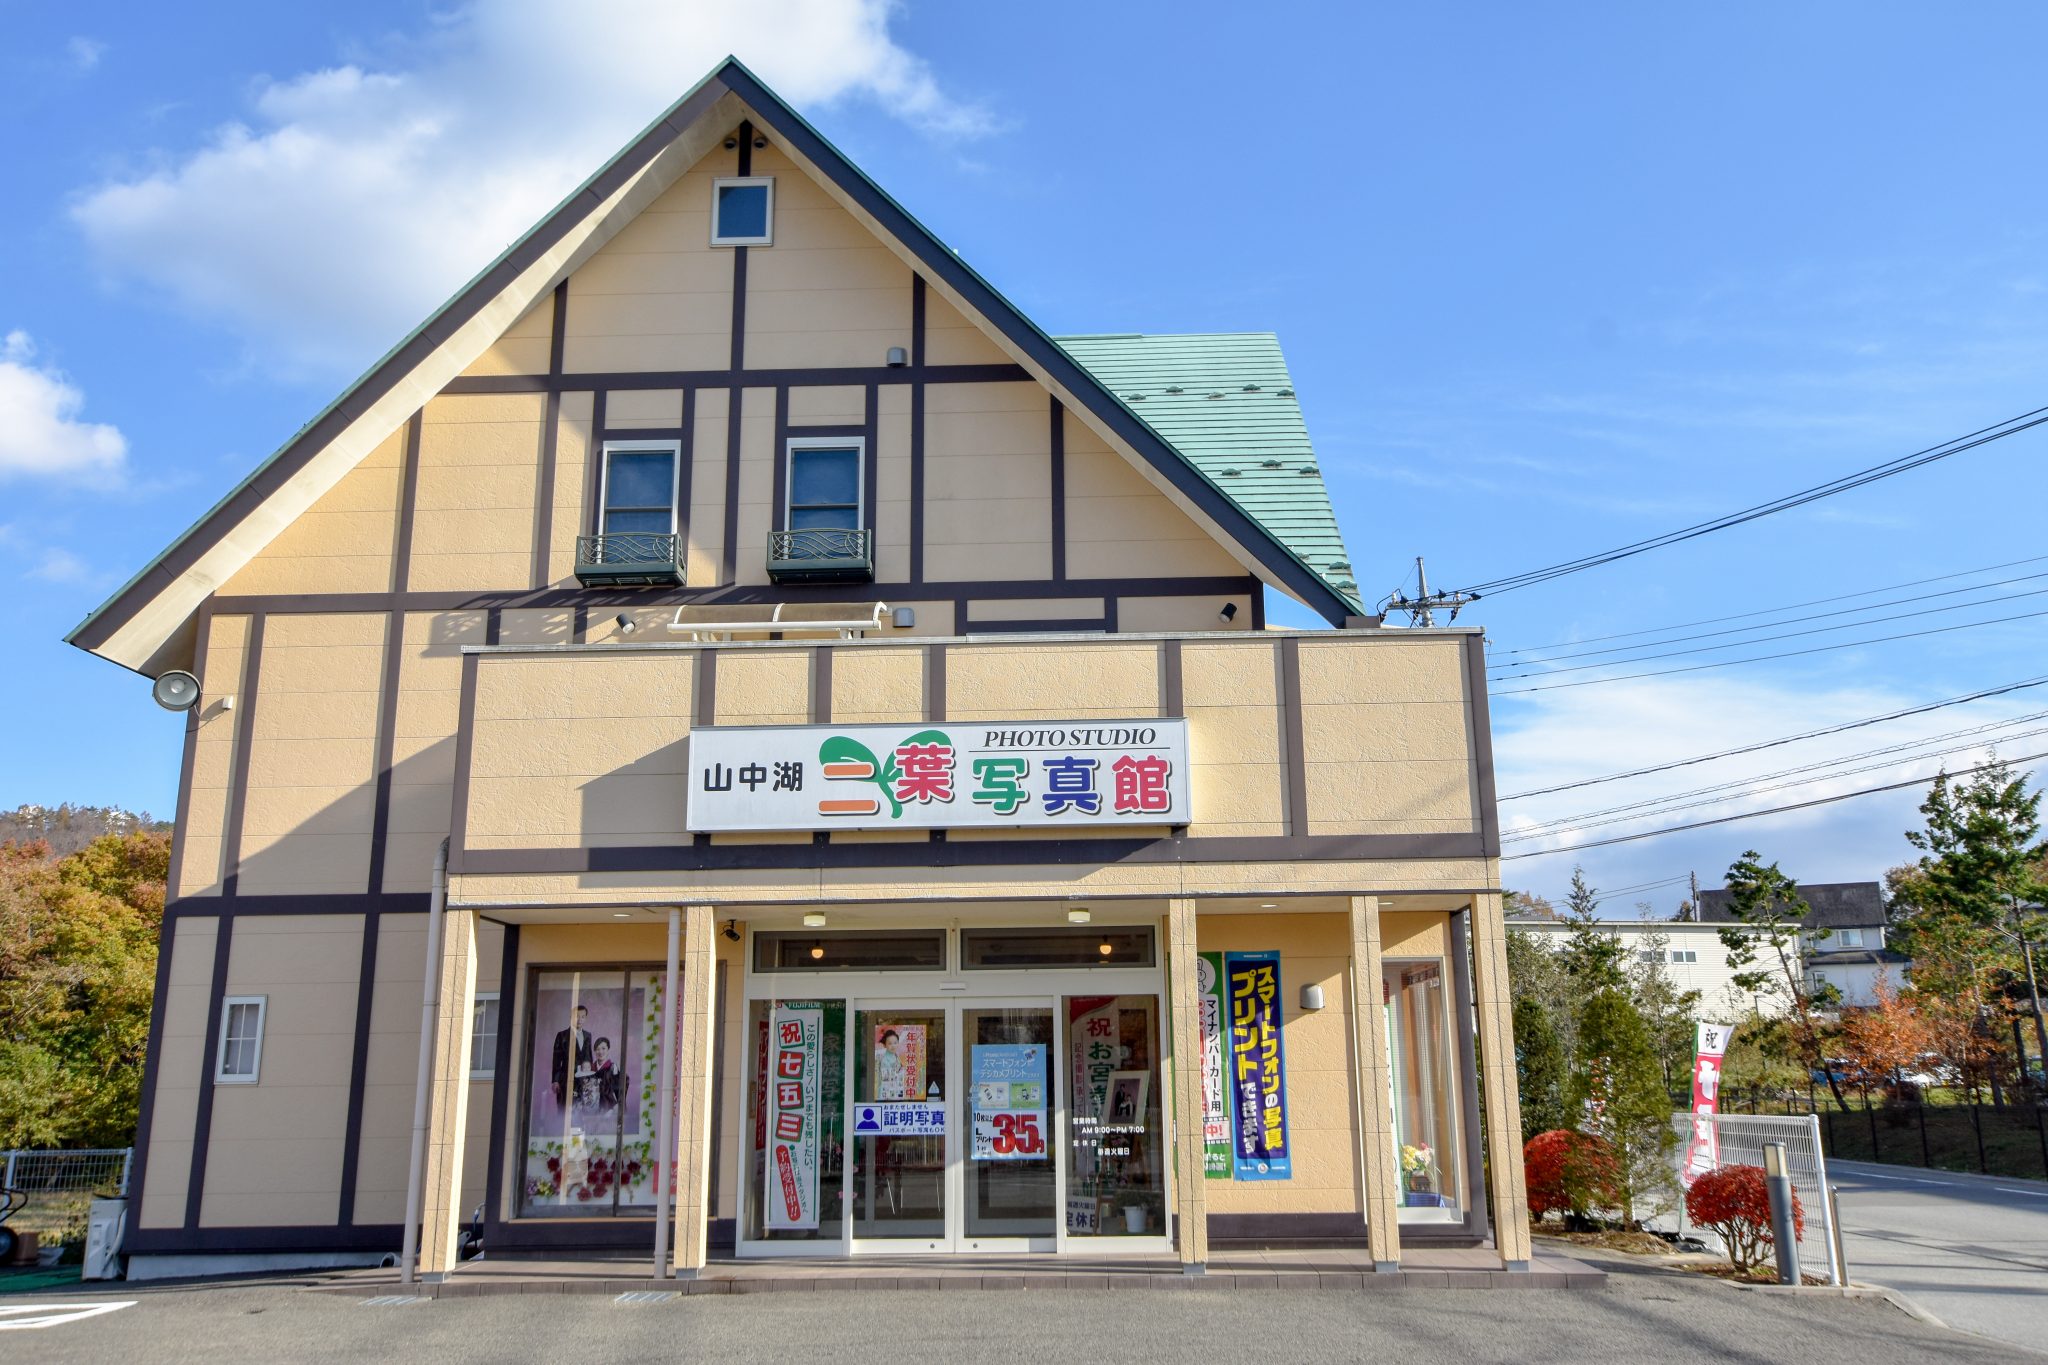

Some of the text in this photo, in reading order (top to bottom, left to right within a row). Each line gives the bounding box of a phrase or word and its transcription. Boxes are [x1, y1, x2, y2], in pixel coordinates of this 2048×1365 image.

[983, 728, 1157, 748] PHOTO STUDIO
[704, 742, 1173, 815] 山中湖 二葉写真館
[905, 1031, 917, 1098] 年賀状受付中
[1207, 1000, 1221, 1112] マイナンバーカード用
[1231, 969, 1259, 1154] プリントできます
[1257, 965, 1284, 1150] スマートフォンの写真
[1705, 1029, 1718, 1049] 祝
[883, 1110, 945, 1126] 証明写真
[975, 1127, 983, 1136] L
